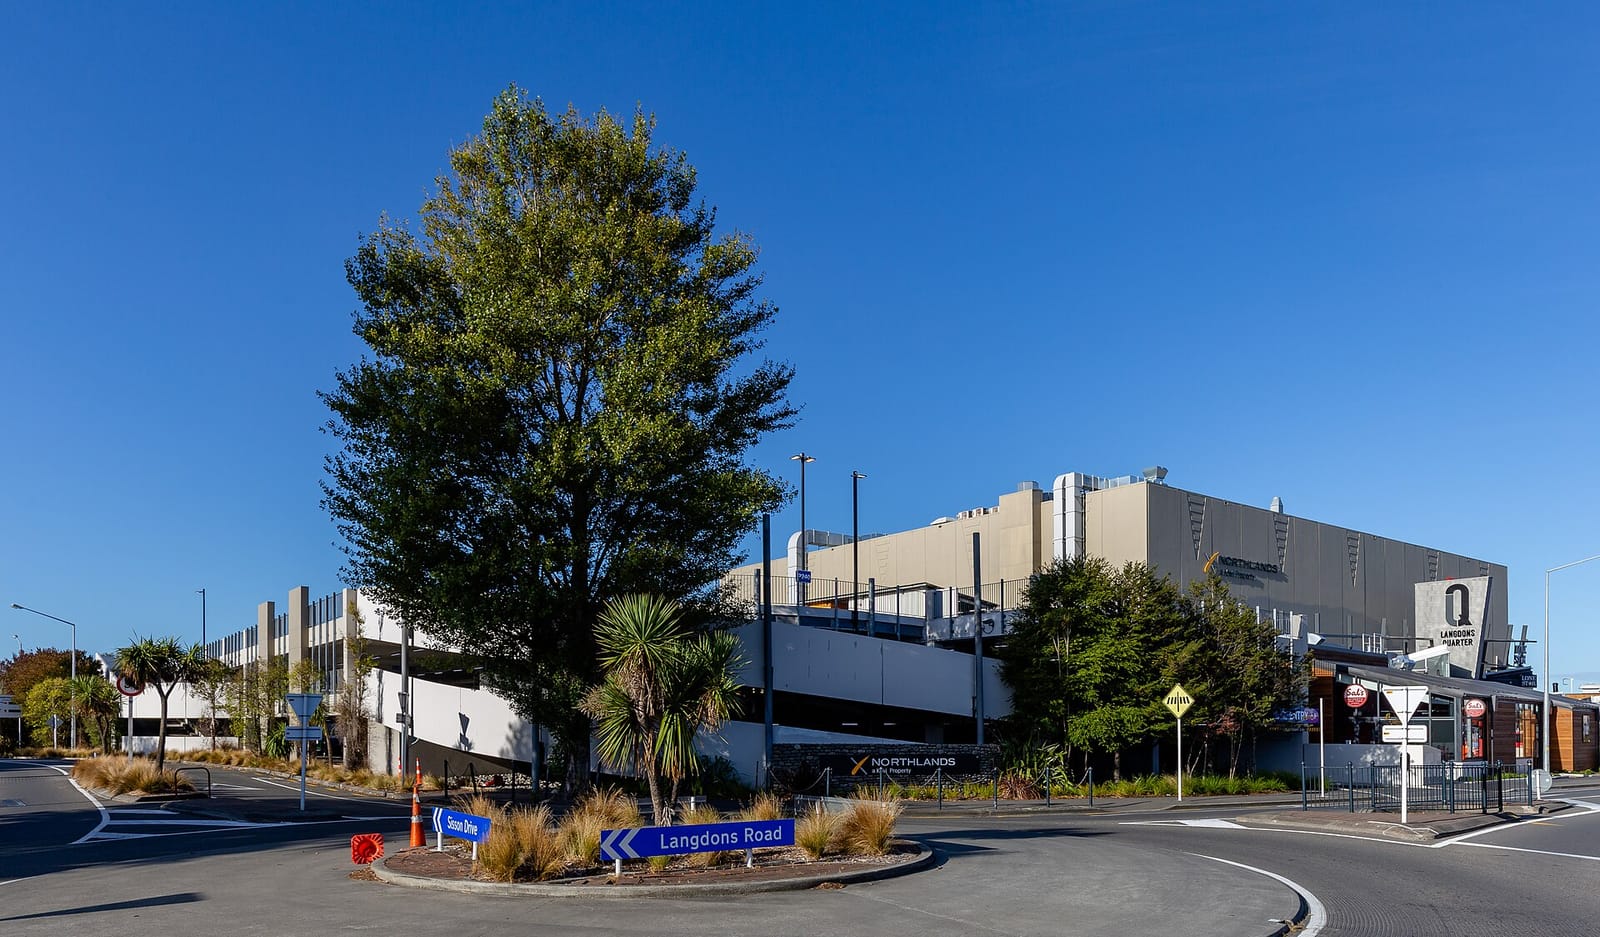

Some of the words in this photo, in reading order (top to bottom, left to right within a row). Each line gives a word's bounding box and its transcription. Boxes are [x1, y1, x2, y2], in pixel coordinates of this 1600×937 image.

[1217, 555, 1278, 574] NORTHLANDS
[1445, 583, 1473, 627] Q
[1440, 629, 1475, 638] LANGDONS
[871, 758, 956, 767] NORTHLANDS
[889, 767, 912, 775] Property
[447, 815, 464, 832] Sisson
[463, 819, 478, 836] Drive
[660, 831, 738, 849] Langdons
[744, 825, 782, 842] Road
